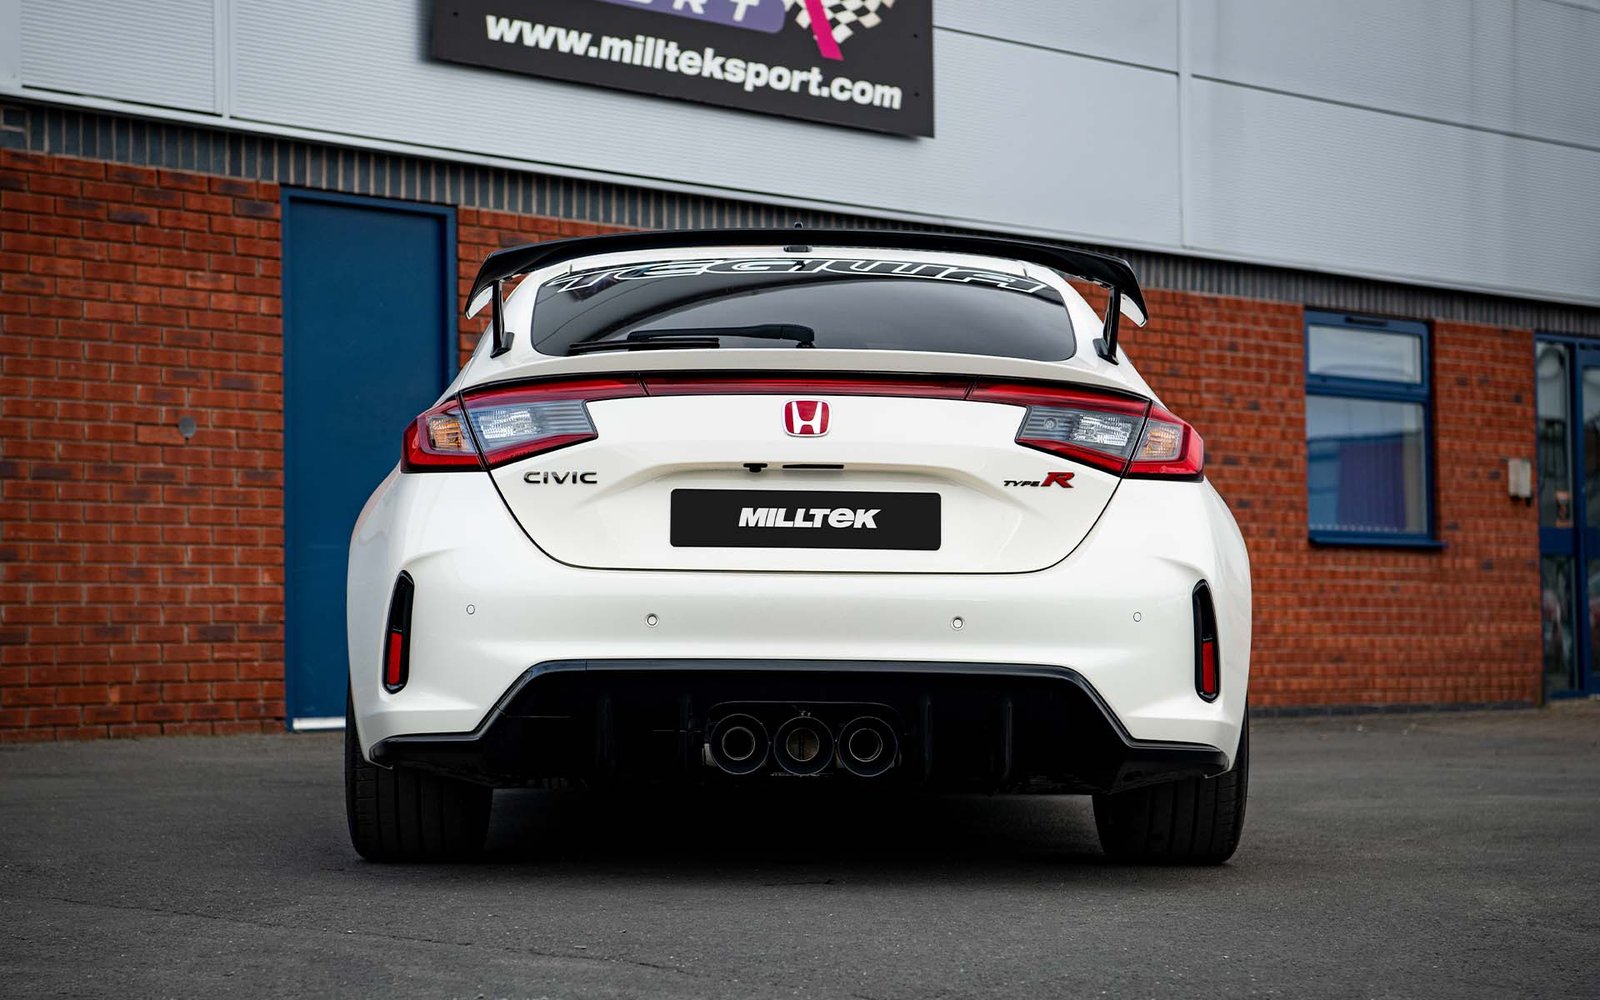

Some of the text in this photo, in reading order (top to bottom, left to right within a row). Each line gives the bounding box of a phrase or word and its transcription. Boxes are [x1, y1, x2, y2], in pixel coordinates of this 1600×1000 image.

[485, 14, 902, 110] www.millteksport.com
[523, 471, 598, 485] CIVIC
[1003, 471, 1076, 489] TYPE R
